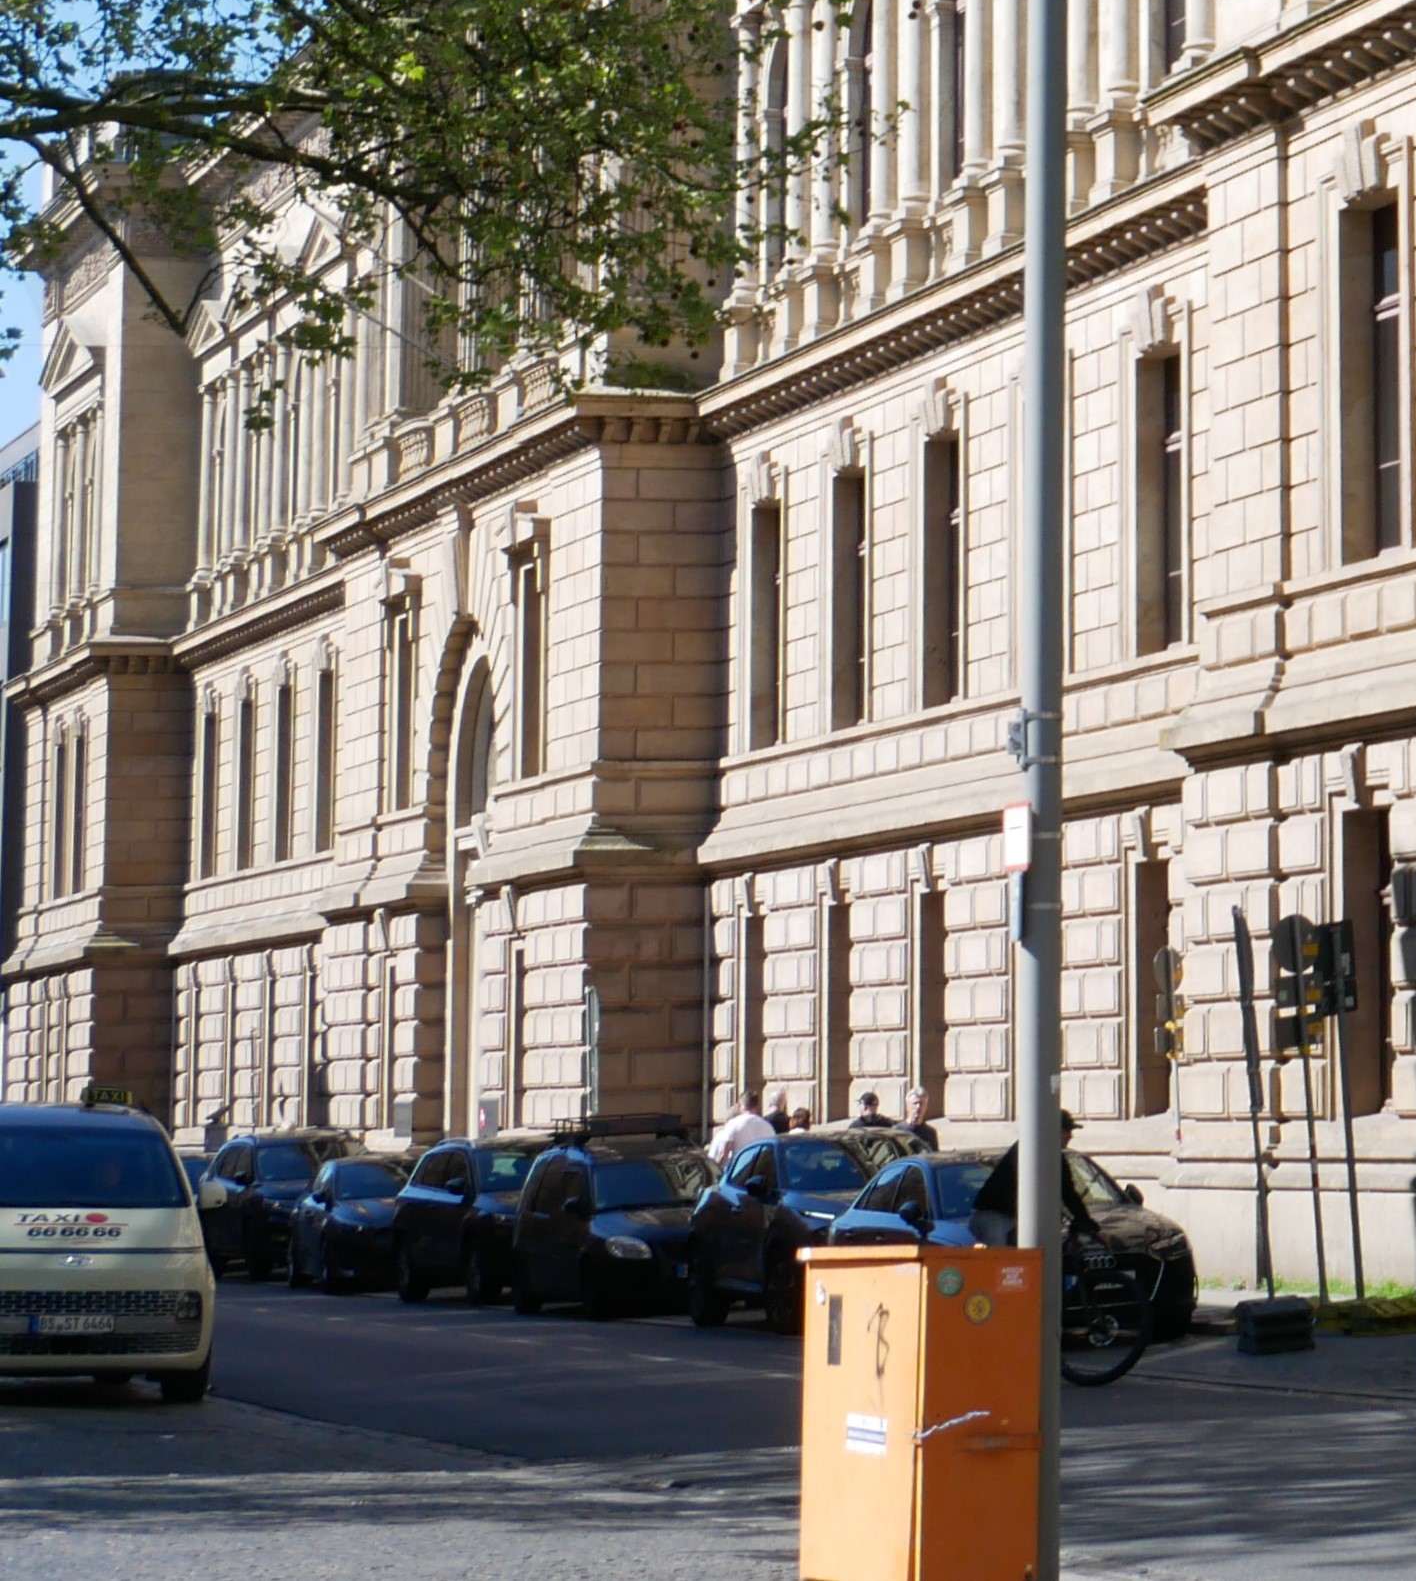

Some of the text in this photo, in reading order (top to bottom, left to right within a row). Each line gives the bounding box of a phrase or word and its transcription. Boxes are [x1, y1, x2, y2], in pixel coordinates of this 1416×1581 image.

[94, 1090, 125, 1102] TAXI
[18, 1213, 80, 1223] TAXI
[27, 1226, 122, 1237] 66 66 66
